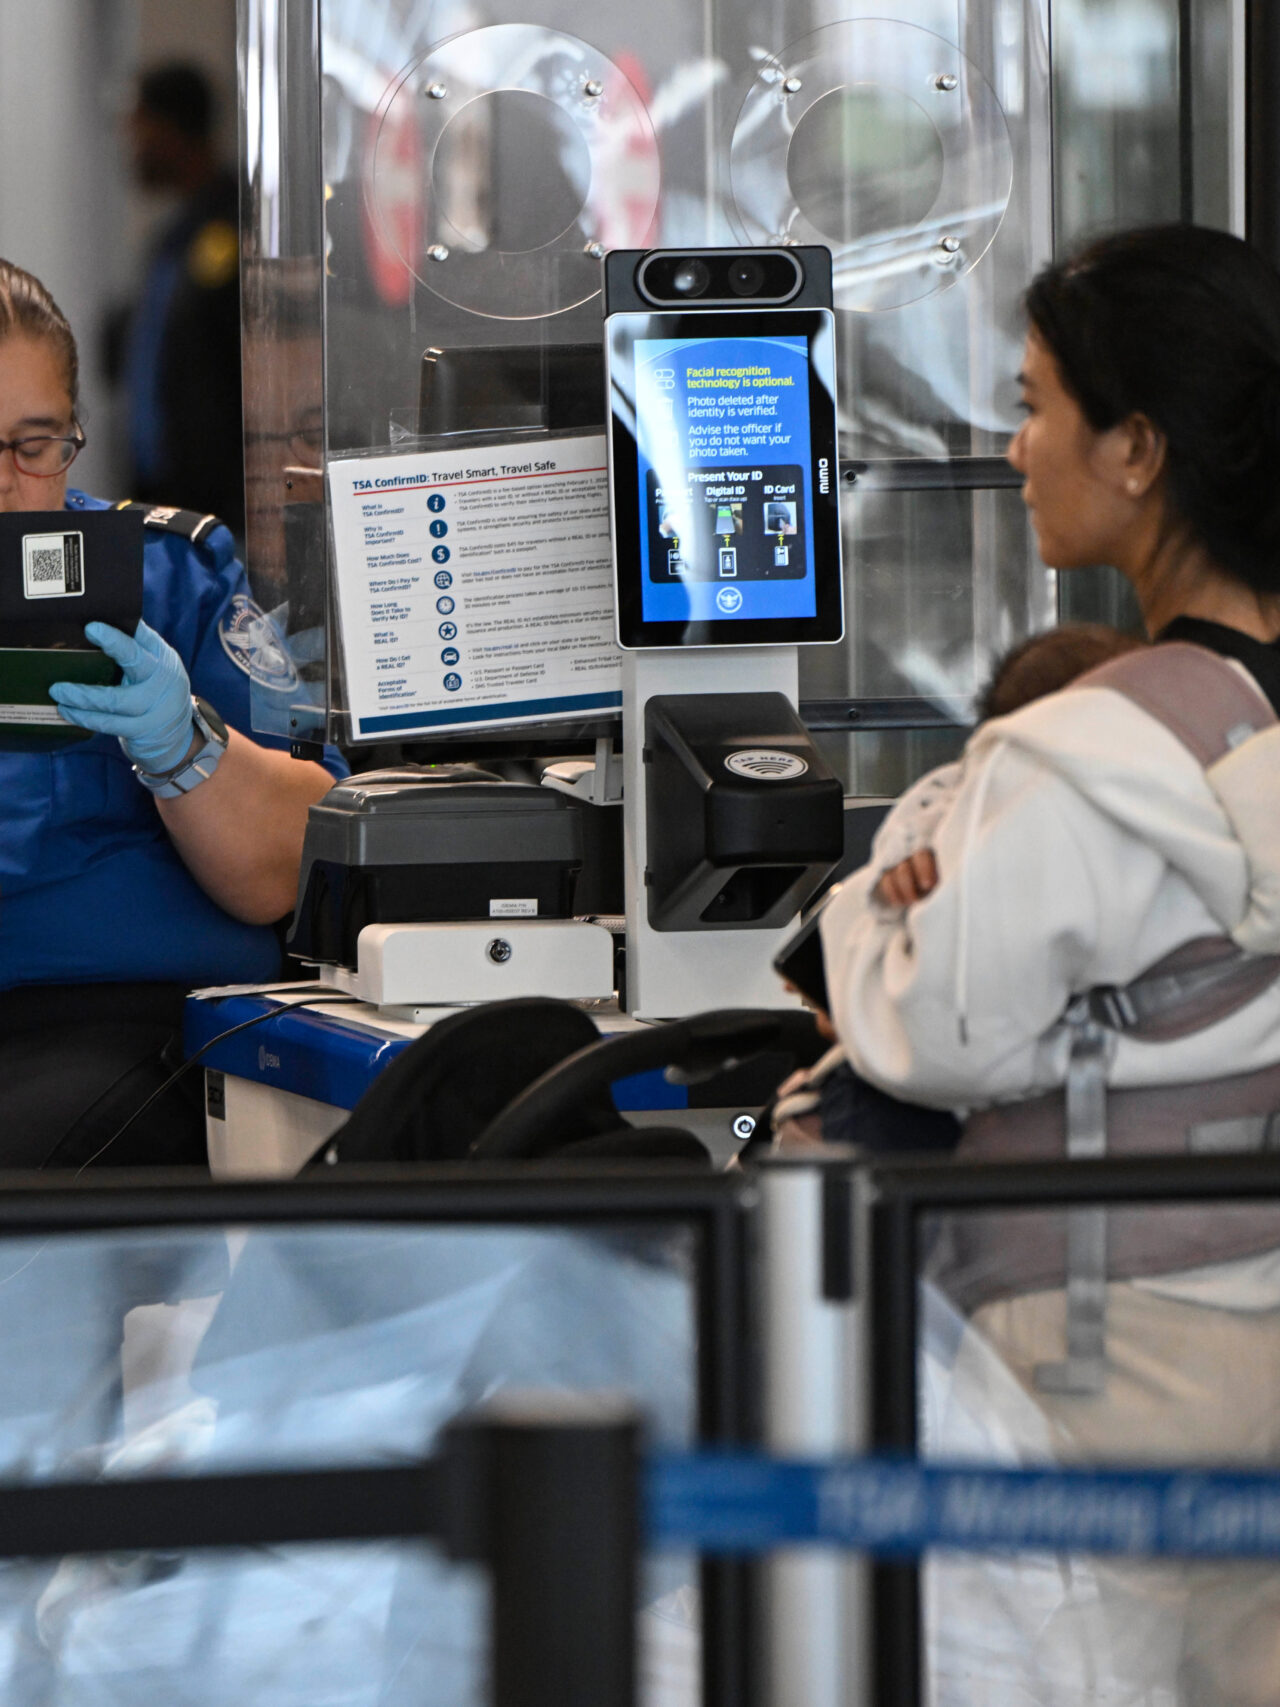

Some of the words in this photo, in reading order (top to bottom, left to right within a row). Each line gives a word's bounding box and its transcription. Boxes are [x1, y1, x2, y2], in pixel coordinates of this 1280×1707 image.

[687, 368, 714, 377] Facial
[716, 366, 771, 377] recognition
[687, 378, 740, 389] technology
[743, 377, 751, 387] is
[752, 376, 795, 387] optional.
[688, 396, 716, 406] Photo
[718, 395, 753, 405] deleted
[756, 394, 779, 404] after
[688, 407, 725, 418] identity
[728, 406, 735, 416] is
[738, 406, 777, 416] verified.
[688, 425, 721, 435] Advise
[723, 424, 739, 434] the
[741, 423, 772, 433] officer
[775, 423, 782, 432] if
[689, 438, 707, 447] you
[709, 436, 722, 446] do
[724, 436, 740, 445] not
[742, 435, 767, 445] want
[769, 435, 791, 445] your
[689, 448, 717, 458] photo
[720, 447, 748, 457] taken.
[353, 480, 372, 492] TSA
[374, 474, 430, 489] ConfirmID:
[432, 470, 464, 483] Travel
[466, 466, 498, 479] Smart,
[501, 463, 533, 476] Travel
[535, 460, 556, 472] Safe
[688, 472, 725, 482] Present
[727, 472, 750, 481] Your
[752, 471, 762, 480] ID
[819, 458, 829, 494] mimo
[706, 486, 734, 496] Digital
[735, 486, 745, 495] ID
[764, 485, 774, 494] ID
[775, 485, 795, 494] Card
